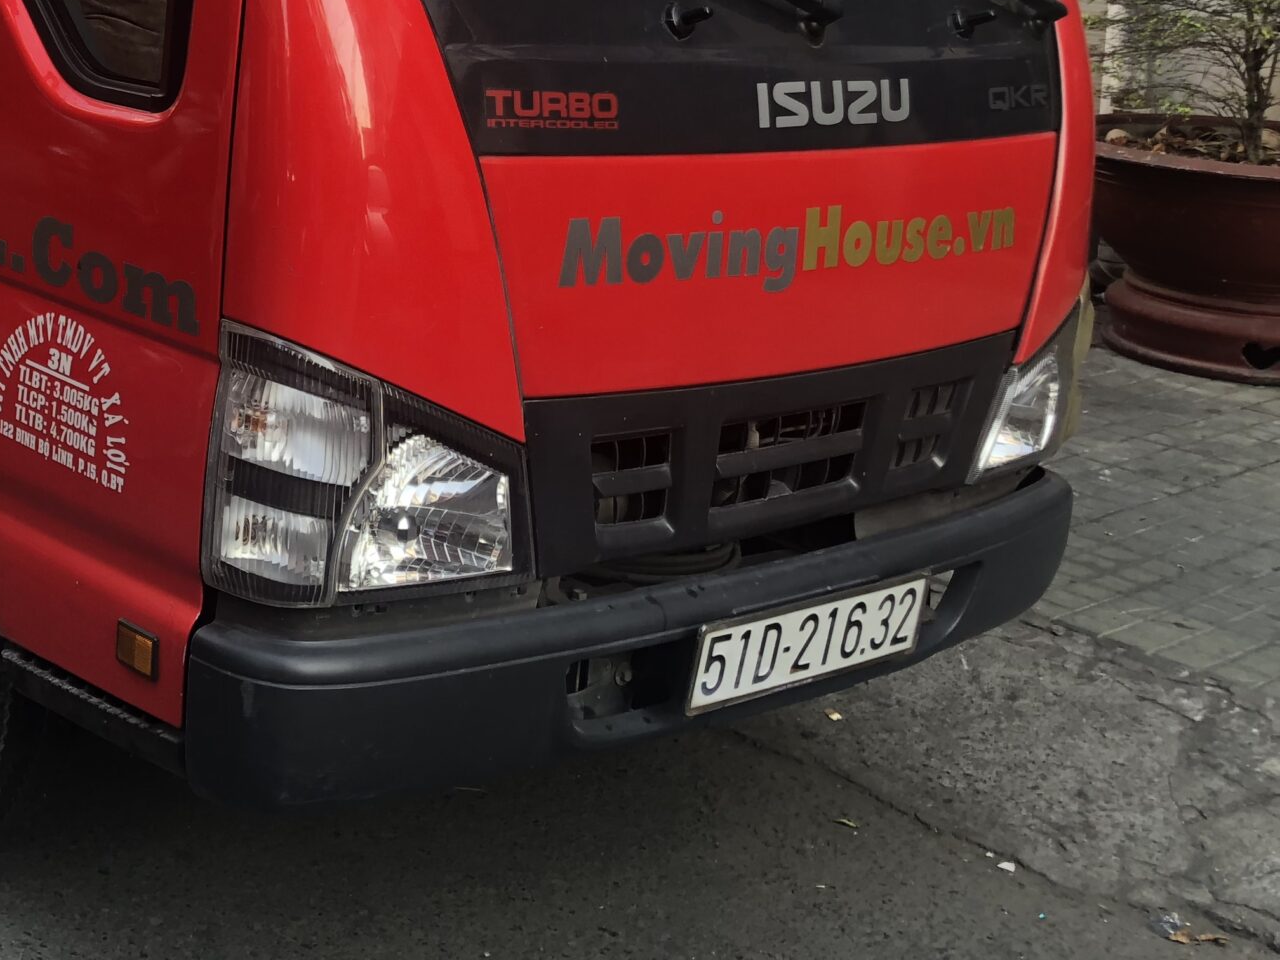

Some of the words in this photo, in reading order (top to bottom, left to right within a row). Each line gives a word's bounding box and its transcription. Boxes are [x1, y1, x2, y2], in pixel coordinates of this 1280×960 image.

[485, 88, 619, 119] TURBO
[487, 118, 619, 129] INTERCOOLED
[756, 78, 911, 129] ISUZU
[988, 84, 1048, 111] QKR
[558, 204, 1016, 293] MovingHouse.vn
[26, 312, 55, 348] MTV
[56, 314, 94, 360] TMDV
[87, 348, 111, 385] VT
[47, 347, 73, 376] 3N
[17, 384, 48, 415] TLCP:
[51, 400, 97, 437] 1.500KG
[19, 364, 51, 394] TLBT:
[53, 381, 100, 417] 3.005KG
[0, 419, 14, 440] 122
[101, 469, 124, 493] Q.BT
[15, 403, 47, 434] TLTB:
[50, 421, 95, 457] 4.700KG
[701, 587, 918, 696] 51D-216.32
